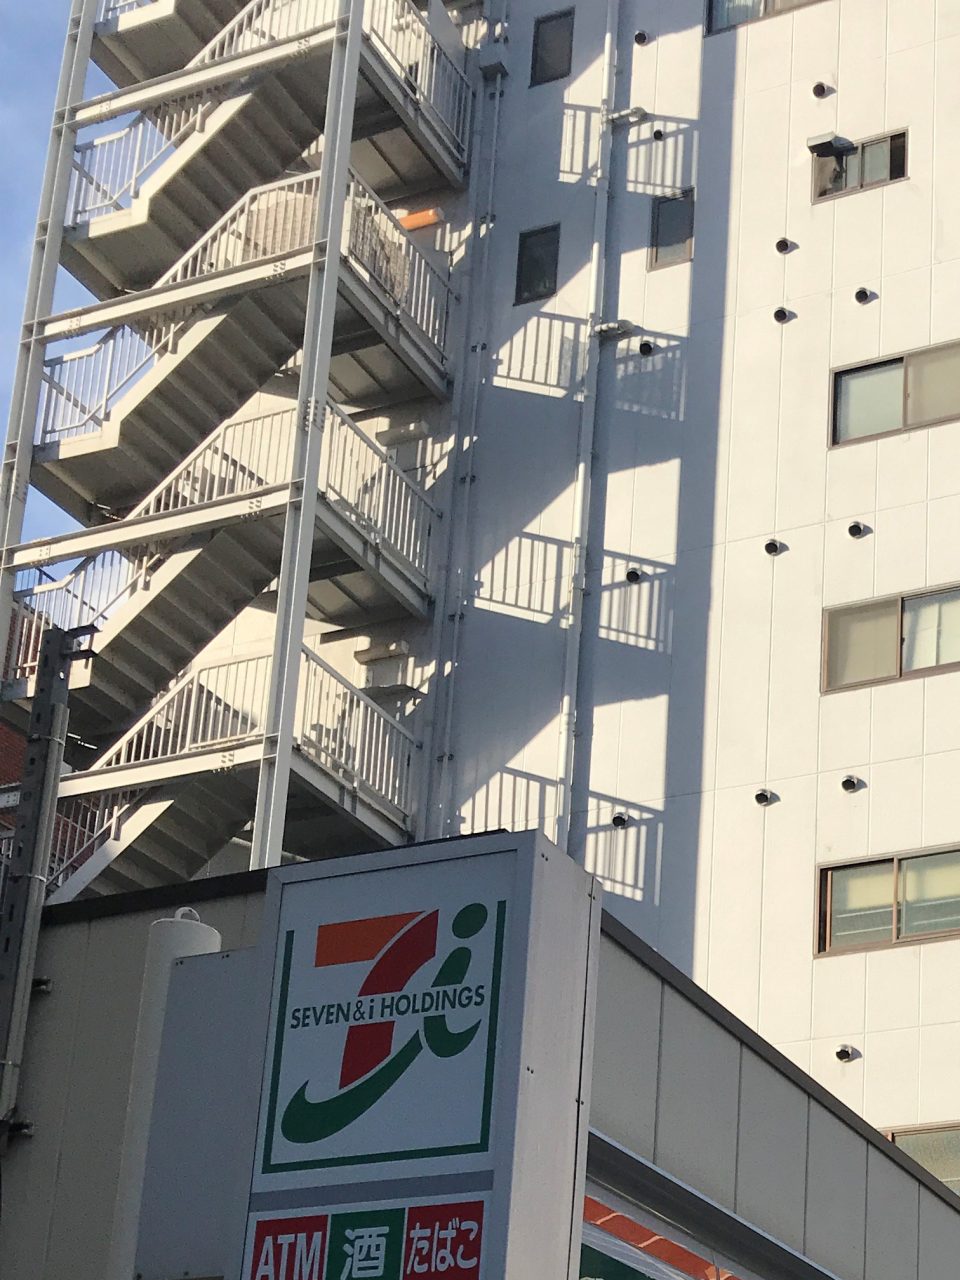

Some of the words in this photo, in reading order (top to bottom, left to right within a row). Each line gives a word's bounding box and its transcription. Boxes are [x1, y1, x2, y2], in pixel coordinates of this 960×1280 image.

[380, 985, 485, 1017] HOLDINGS
[407, 1218, 479, 1275] たばこ
